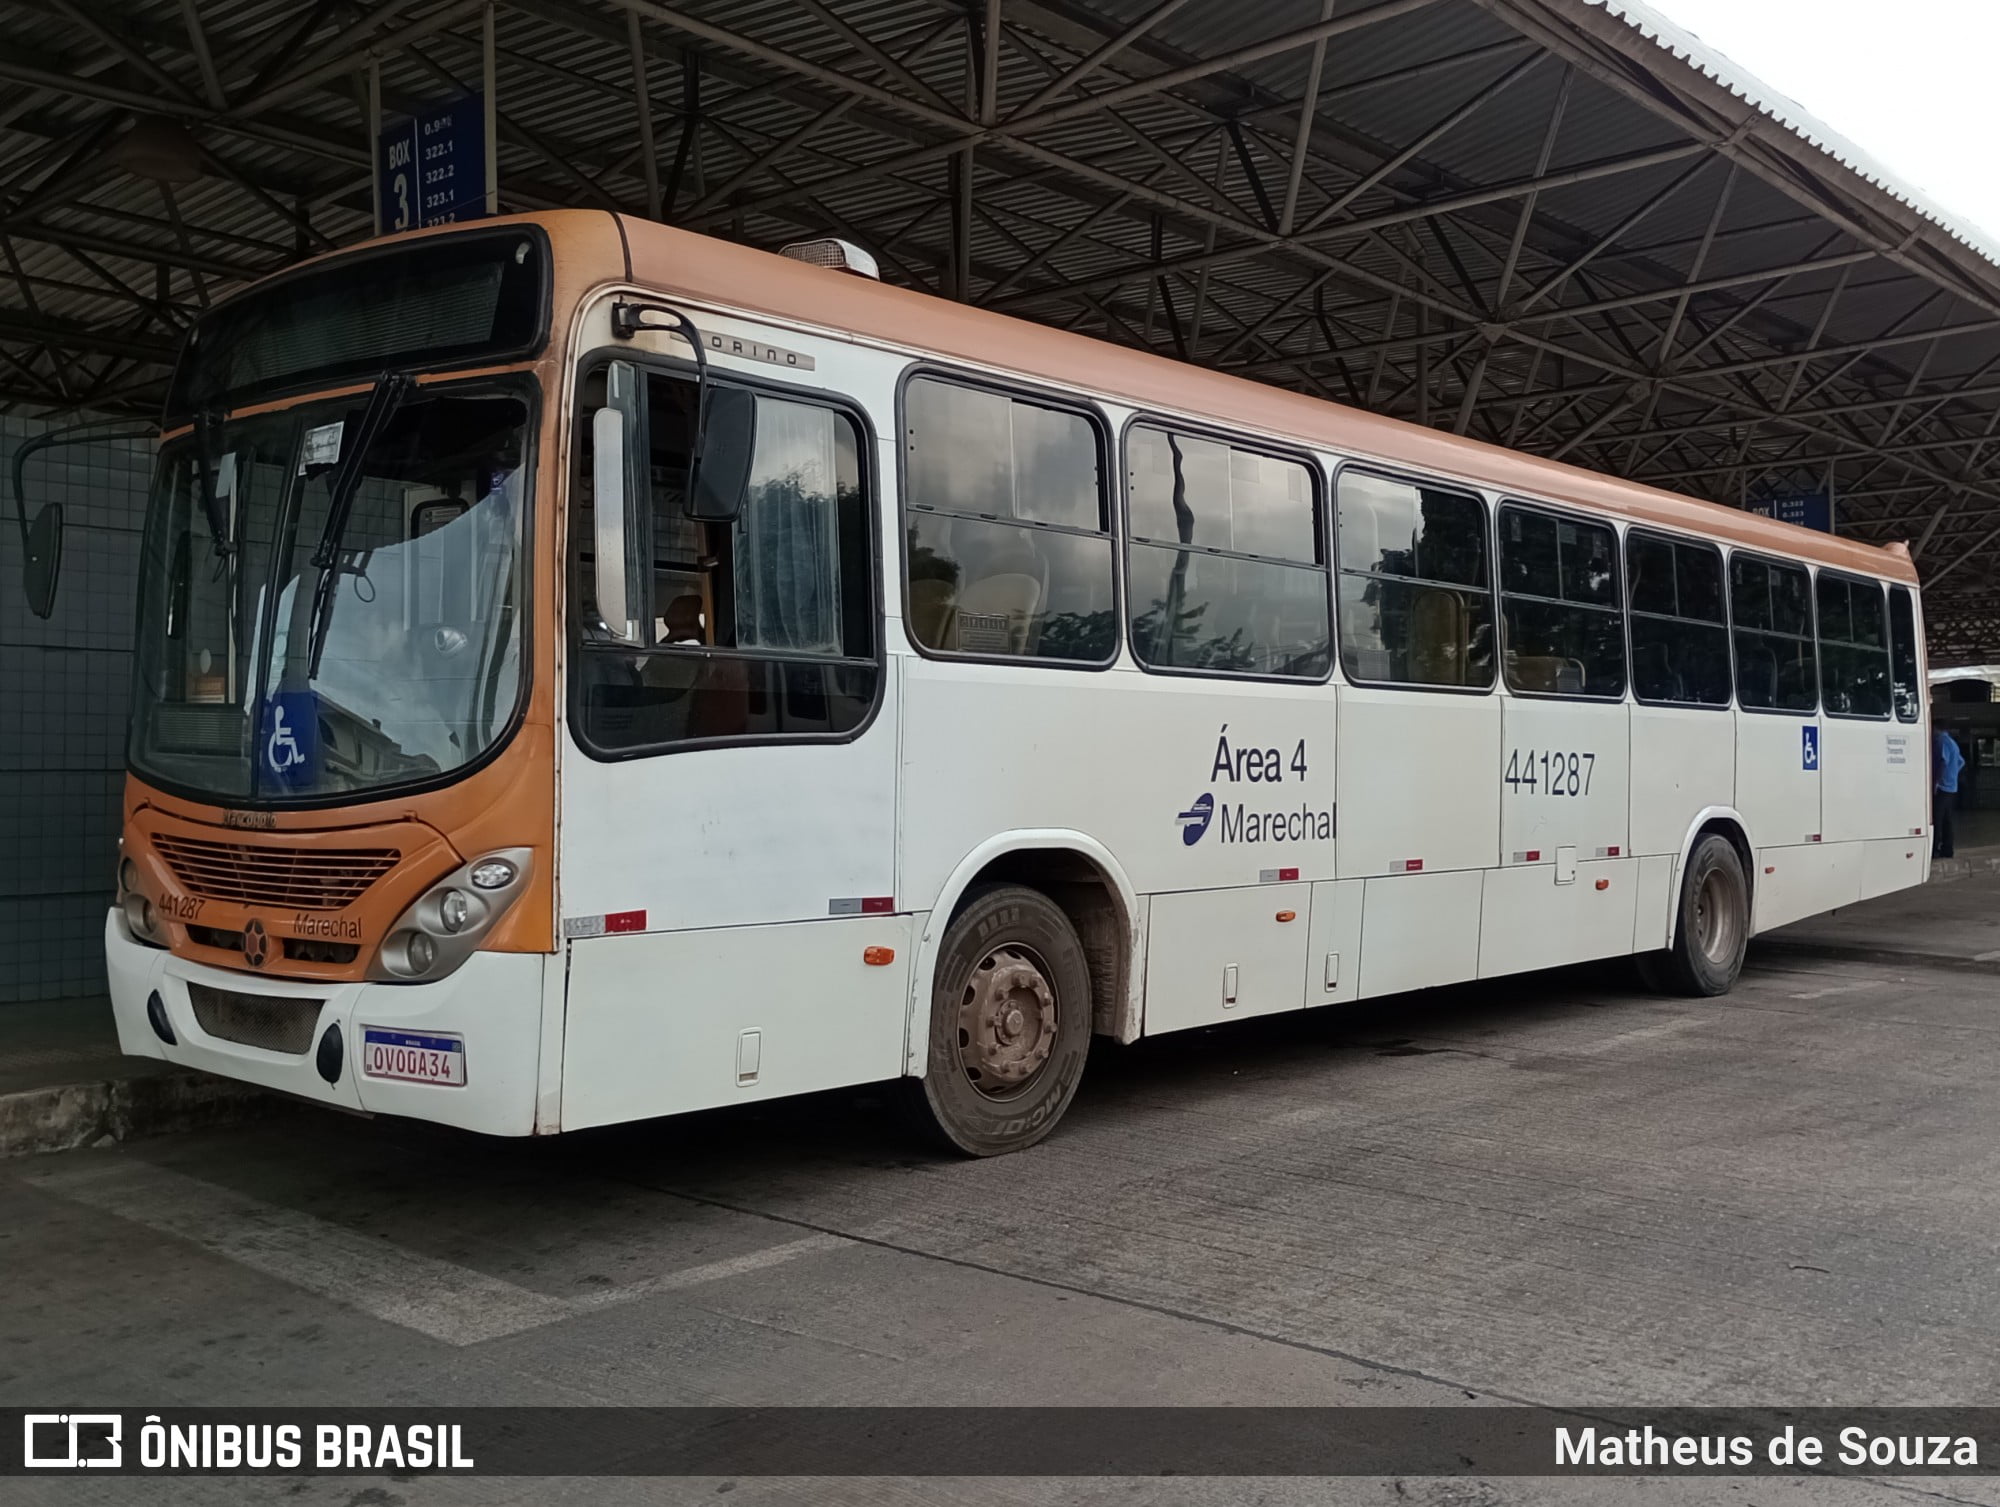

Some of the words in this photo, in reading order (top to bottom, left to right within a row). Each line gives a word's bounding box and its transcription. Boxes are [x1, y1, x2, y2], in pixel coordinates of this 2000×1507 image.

[388, 138, 411, 170] BOX
[425, 140, 454, 160] 322.1
[425, 164, 455, 184] 322.2
[393, 173, 409, 231] 3
[426, 189, 455, 208] 323.1
[710, 335, 797, 365] ORINO
[1210, 723, 1282, 783] Área
[1290, 738, 1308, 782] 4
[1504, 748, 1595, 797] 441287
[1221, 801, 1337, 844] Marechal
[158, 893, 206, 920] 441287
[293, 912, 362, 939] Marechal
